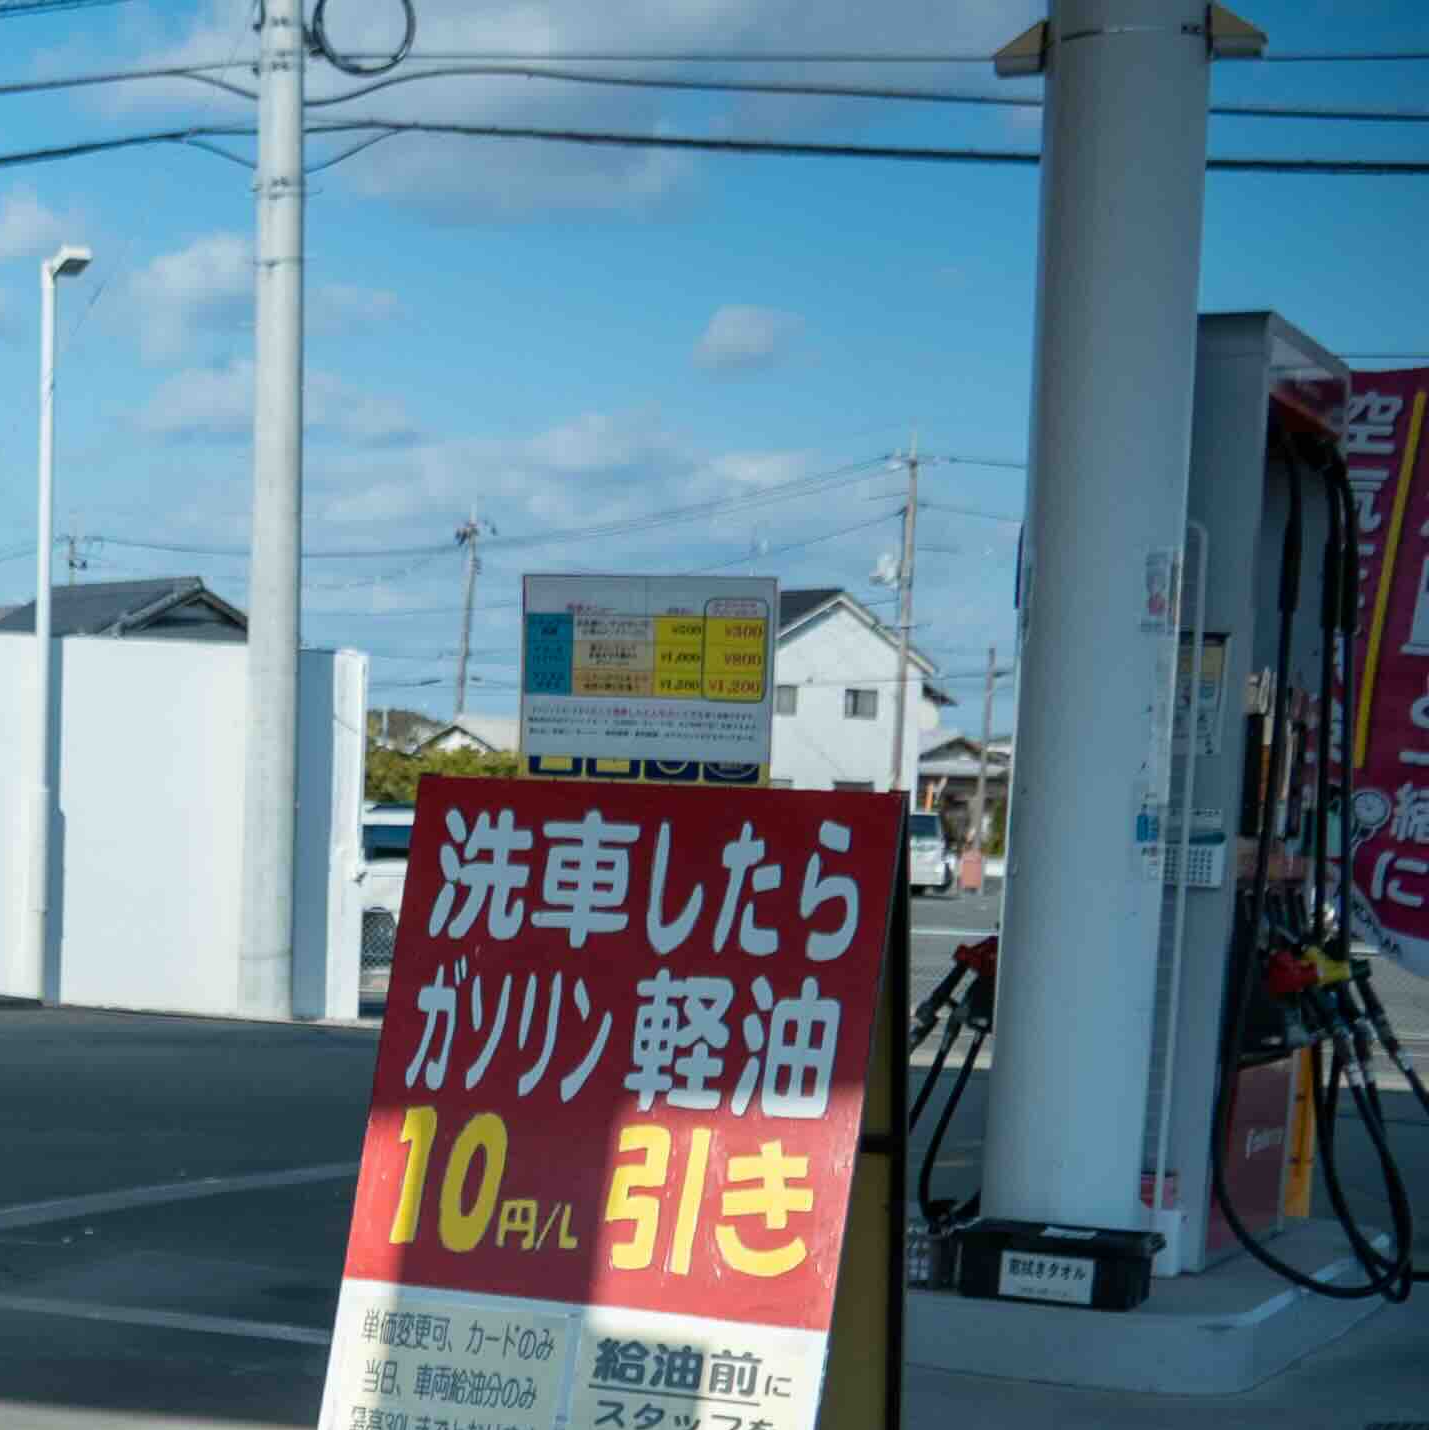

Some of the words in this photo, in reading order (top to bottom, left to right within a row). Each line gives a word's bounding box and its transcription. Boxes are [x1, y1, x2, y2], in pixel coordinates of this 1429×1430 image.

[428, 808, 860, 962] 洗車したら
[592, 1336, 793, 1399] 給油前に
